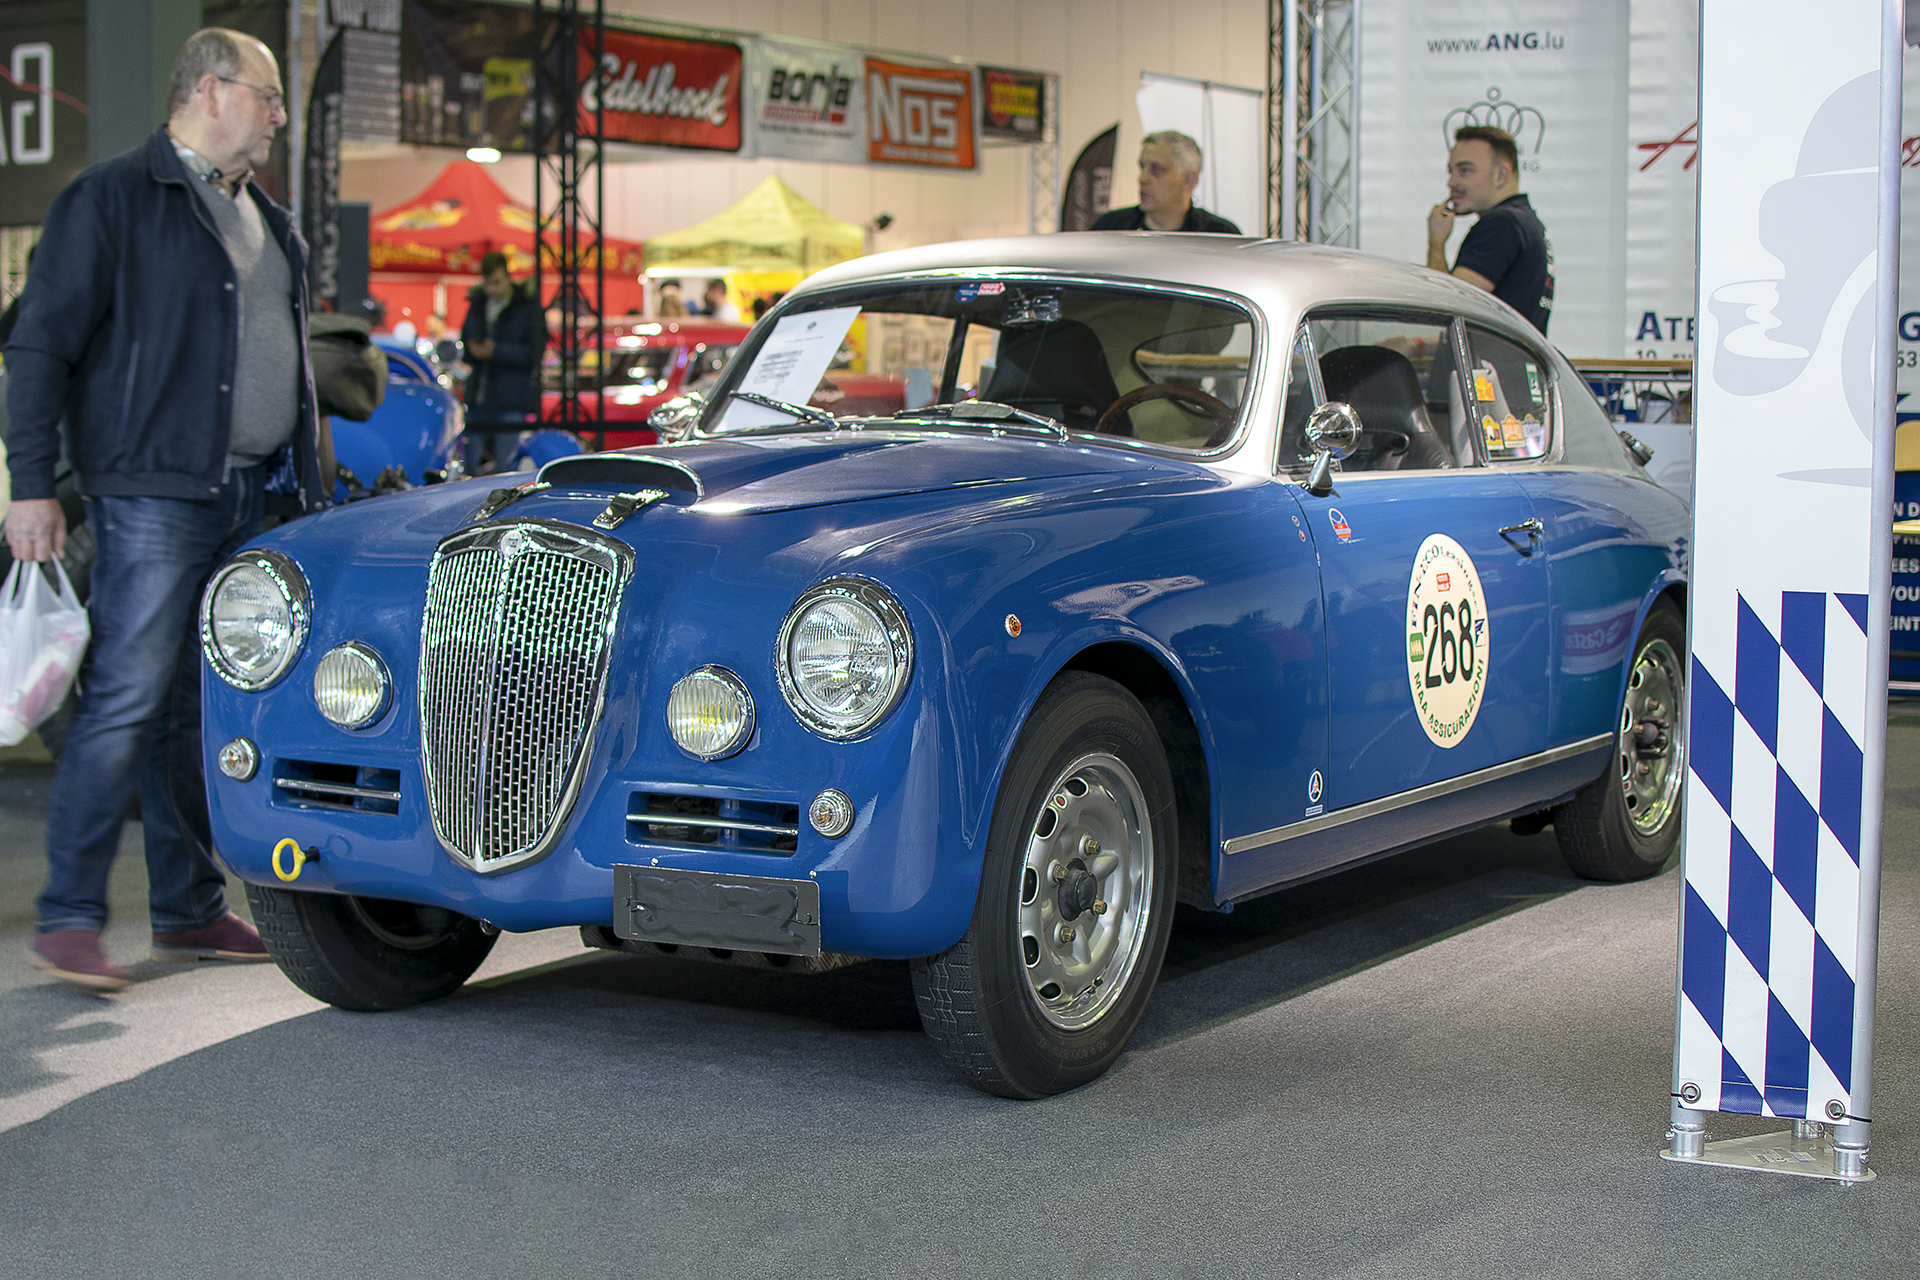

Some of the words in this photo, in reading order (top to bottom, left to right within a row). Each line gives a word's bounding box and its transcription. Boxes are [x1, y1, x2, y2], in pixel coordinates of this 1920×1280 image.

[1426, 31, 1565, 53] www.ANG.lu
[580, 53, 729, 126] Edelbrock
[870, 71, 965, 149] NOS
[1424, 598, 1474, 689] 268
[1414, 671, 1428, 715] MAA
[1427, 658, 1484, 738] ASSICURAZIONI
